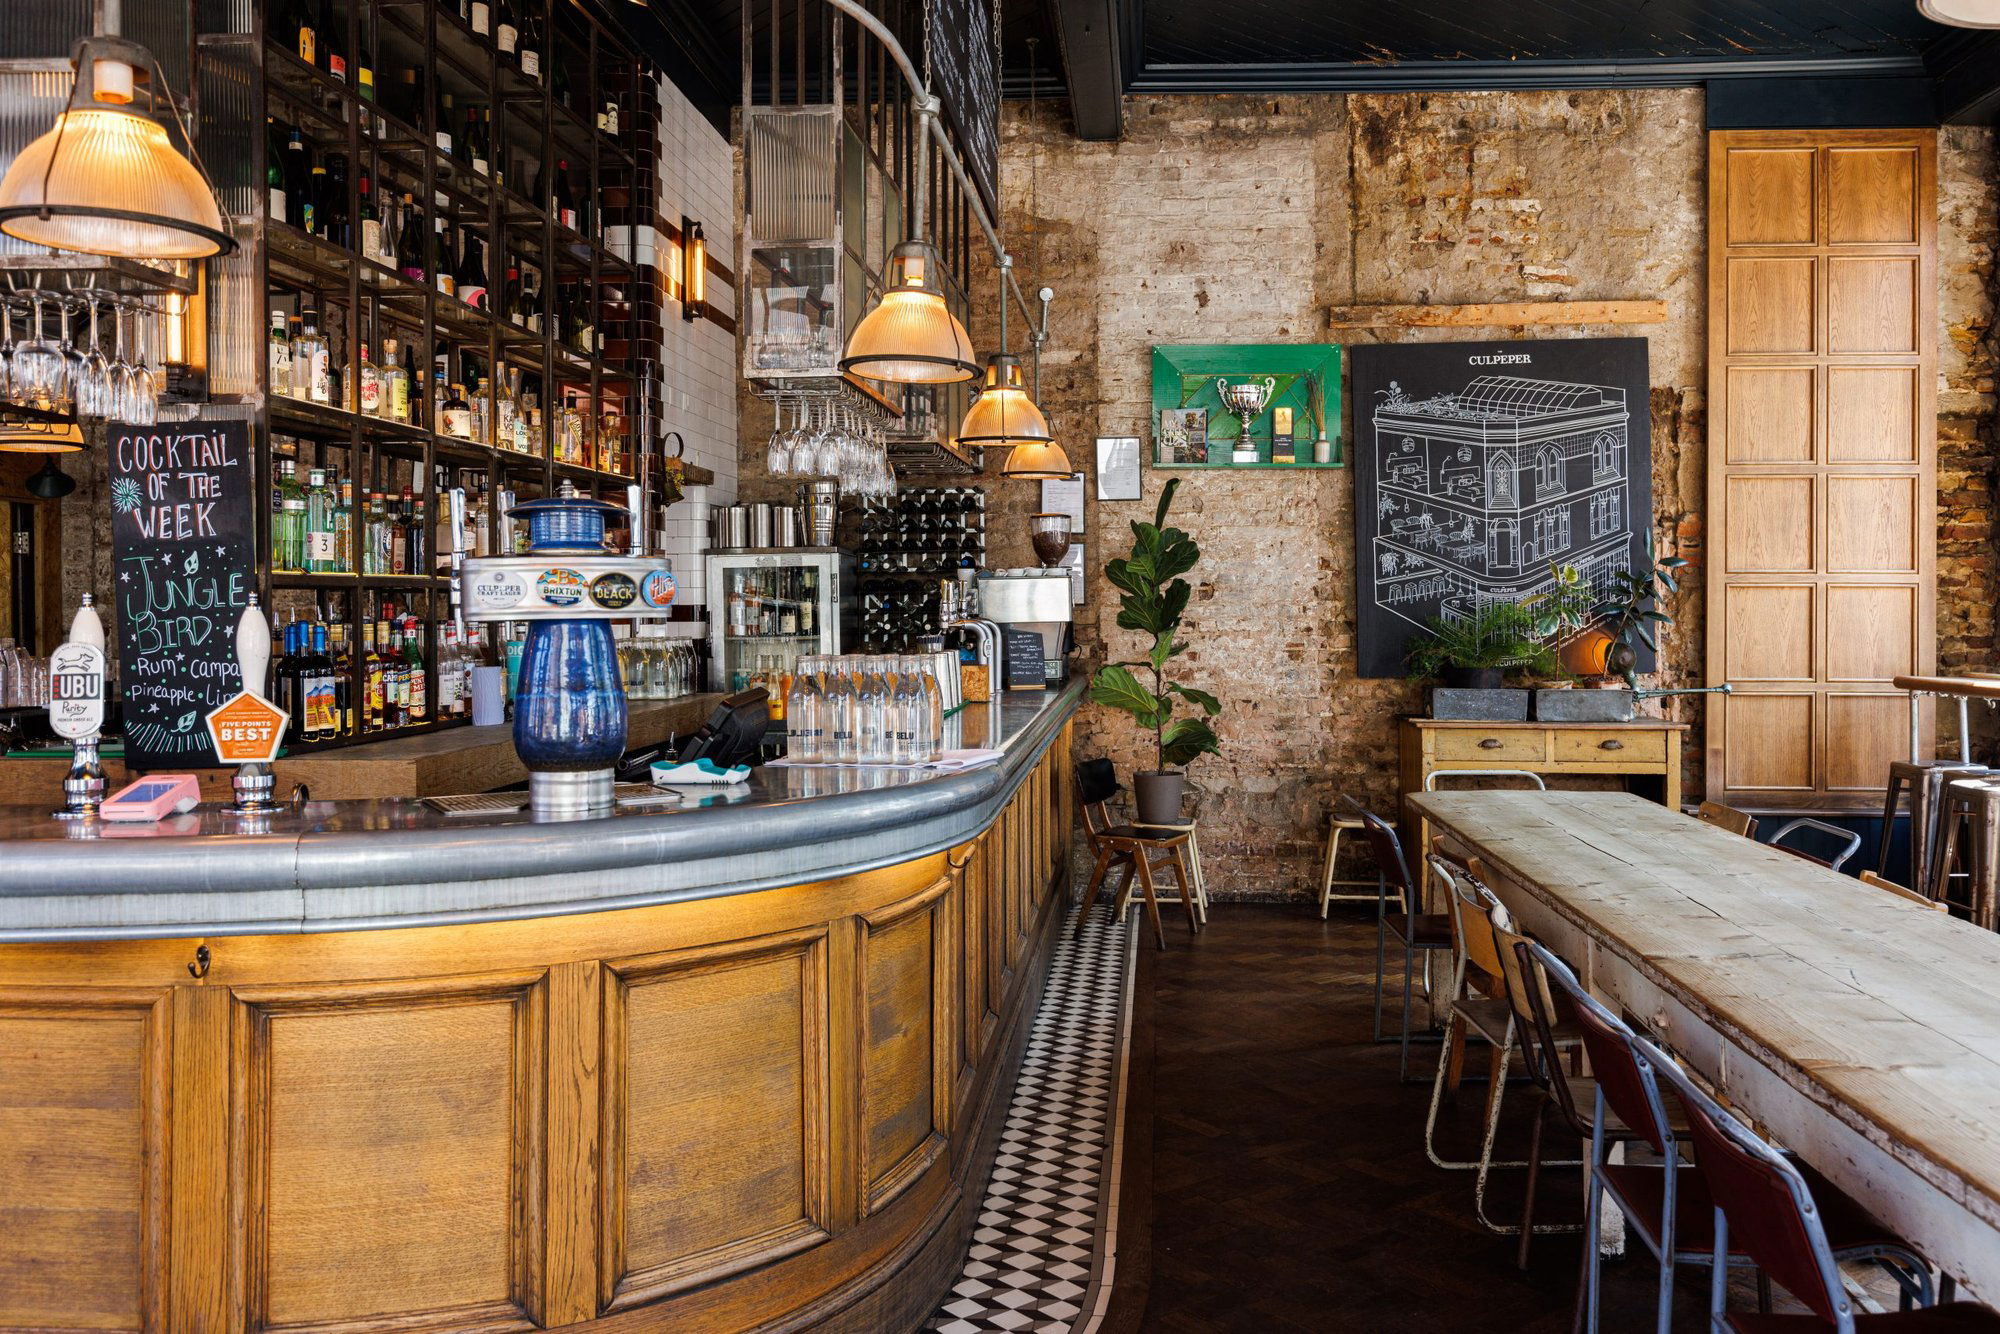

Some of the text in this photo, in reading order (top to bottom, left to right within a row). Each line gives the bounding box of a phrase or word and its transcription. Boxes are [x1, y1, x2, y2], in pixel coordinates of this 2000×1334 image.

[1468, 354, 1532, 366] CULPEPER
[147, 472, 222, 501] OF THE
[132, 502, 217, 540] WEEK
[321, 538, 328, 552] 3
[122, 556, 246, 623] JUNGLE
[543, 586, 582, 596] BRIXTON
[596, 587, 633, 599] BLACK
[135, 610, 212, 654] BIRD
[137, 657, 242, 686] Rum Campa
[60, 674, 99, 698] UBU
[62, 701, 88, 717] Purity
[221, 728, 272, 741] BEST
[834, 731, 853, 739] BELU
[896, 731, 914, 740] BELU
